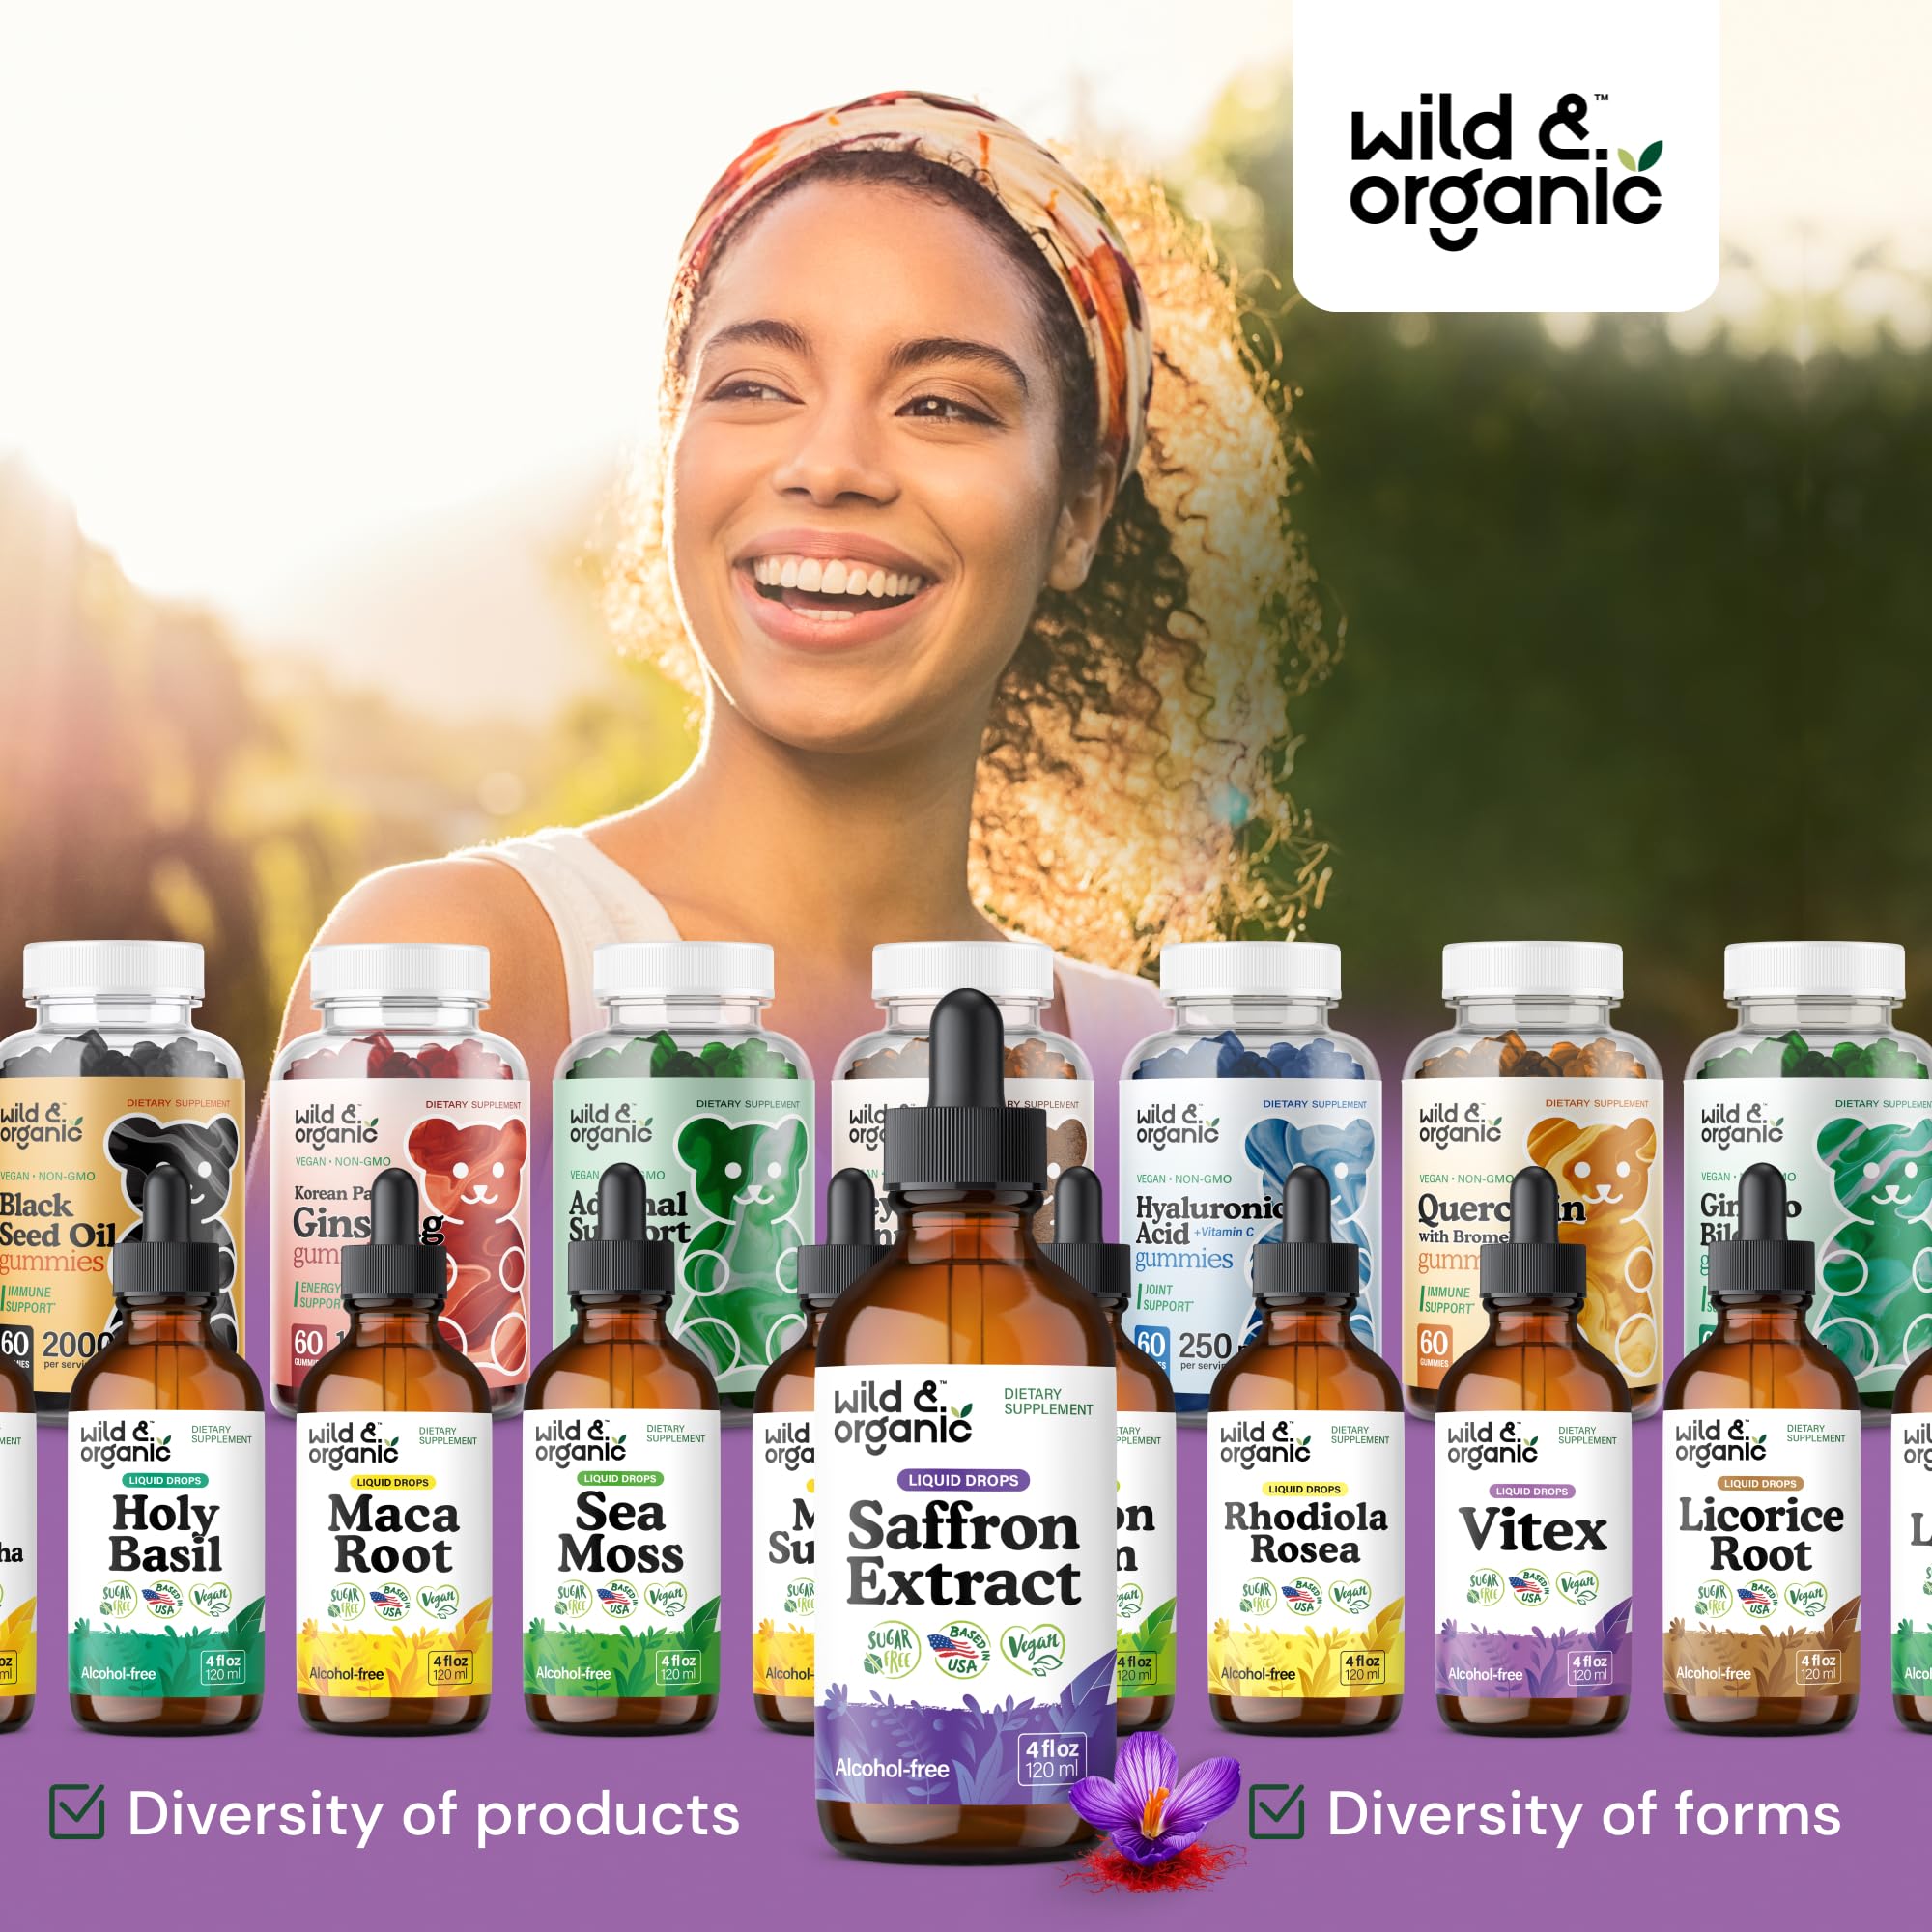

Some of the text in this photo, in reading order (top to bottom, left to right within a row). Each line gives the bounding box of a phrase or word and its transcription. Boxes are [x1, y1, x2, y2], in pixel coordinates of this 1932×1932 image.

[1351, 93, 1512, 160] wild
[1539, 93, 1589, 160] &
[1350, 149, 1662, 252] organic
[1, 1103, 61, 1123] wild &
[175, 1099, 230, 1108] SUPPLEMENT
[296, 1104, 356, 1123] wild &
[426, 1100, 468, 1109] DIETARY
[571, 1103, 631, 1123] wild &
[745, 1100, 800, 1109] SUPPLEMENT
[1025, 1100, 1079, 1109] SUPPLEMENT
[1137, 1104, 1199, 1123] wild &
[1264, 1100, 1367, 1109] DIETARY SUPPLEMENT
[1420, 1103, 1480, 1123] wild &
[1547, 1099, 1648, 1108] DIETARY SUPPLEMENT
[1701, 1103, 1762, 1123] wild &
[1, 1120, 82, 1150] organic
[296, 1121, 378, 1151] organic
[571, 1120, 652, 1151] organic
[1137, 1121, 1219, 1151] organic
[1419, 1120, 1501, 1150] organic
[1701, 1120, 1782, 1150] organic
[296, 1157, 391, 1166] VEGAN NON-GMO
[1, 1172, 96, 1181] VEGAN NON-GMO
[571, 1171, 600, 1179] VEGAN
[1137, 1175, 1232, 1183] VEGAN NON-GMO
[1420, 1175, 1515, 1183] VEGAN NON-GMO
[1701, 1172, 1730, 1180] VEGAN
[295, 1186, 348, 1201] Korean
[0, 1193, 74, 1216] Black
[1418, 1193, 1586, 1227] Quercin
[1701, 1193, 1802, 1217] Gino
[0, 1223, 115, 1247] Seed Oil
[294, 1207, 444, 1245] Ginsg
[569, 1217, 691, 1244] Suort
[1136, 1223, 1254, 1245] Acid +Vitamin C
[1419, 1230, 1449, 1243] with
[0, 1250, 103, 1275] gummies
[1136, 1249, 1233, 1272] gummies
[8, 1287, 51, 1297] IMMUNE
[301, 1283, 341, 1293] ENERGY
[1145, 1285, 1173, 1295] JOINT
[1427, 1287, 1470, 1298] IMMUNE
[300, 1297, 341, 1310] SUPPOR
[1, 1332, 29, 1355] 60
[295, 1330, 323, 1354] 60
[1137, 1332, 1232, 1358] 60 250
[1420, 1330, 1447, 1354] 60
[43, 1360, 87, 1369] per servi
[1180, 1361, 1194, 1370] per
[1420, 1358, 1449, 1367] GUMMIES
[835, 1380, 939, 1413] wild &
[1005, 1388, 1061, 1400] DIETARY
[1005, 1403, 1093, 1415] SUPPLEMENT
[81, 1421, 125, 1442] wild
[309, 1422, 353, 1443] wild
[419, 1436, 476, 1445] SUPPLEMENT
[536, 1420, 580, 1441] wild
[835, 1406, 972, 1455] organic
[1221, 1421, 1264, 1442] wild
[1331, 1435, 1389, 1444] SUPPLEMENT
[1449, 1422, 1492, 1442] wild
[1676, 1420, 1719, 1441] wild
[81, 1437, 171, 1469] organic
[309, 1439, 398, 1470] organic
[536, 1437, 626, 1468] organic
[1221, 1438, 1311, 1470] organic
[1448, 1439, 1538, 1470] organic
[1676, 1436, 1767, 1468] organic
[129, 1477, 163, 1486] LIQUID
[357, 1479, 391, 1488] LIQUID
[584, 1474, 656, 1484] LIQUID DROPS
[909, 1474, 1018, 1488] LIQUID DROPS
[1724, 1480, 1759, 1489] LIQUID
[1496, 1488, 1530, 1496] LIQUID
[113, 1494, 219, 1538] Holy
[328, 1494, 460, 1532] Maca
[576, 1491, 666, 1531] Sea
[1224, 1501, 1388, 1531] Rhodiola
[1680, 1496, 1844, 1532] Licorice
[848, 1500, 1080, 1550] Saffron
[1458, 1507, 1607, 1551] Vitex
[109, 1536, 222, 1571] Basil
[335, 1535, 453, 1573] Root
[558, 1533, 684, 1573] Moss
[1251, 1534, 1360, 1563] Rosea
[1710, 1536, 1812, 1571] Root
[847, 1556, 1081, 1605] Extract
[868, 1630, 912, 1650] SUGAR
[950, 1626, 986, 1649] BASED
[1009, 1634, 1059, 1658] Vegan
[885, 1649, 910, 1667] FREE
[948, 1660, 977, 1673] USA
[81, 1667, 156, 1680] Alcohol-free
[309, 1667, 384, 1680] Alcohol-free
[536, 1667, 611, 1679] Alcohol-free
[1221, 1668, 1295, 1680] Alcohol-free
[1449, 1668, 1522, 1680] Alcohol-free
[1677, 1667, 1751, 1679] Alcohol-free
[1026, 1741, 1079, 1757] 4 fl oz
[836, 1759, 950, 1777] Alcohol-free
[1026, 1762, 1078, 1777] 120 ml
